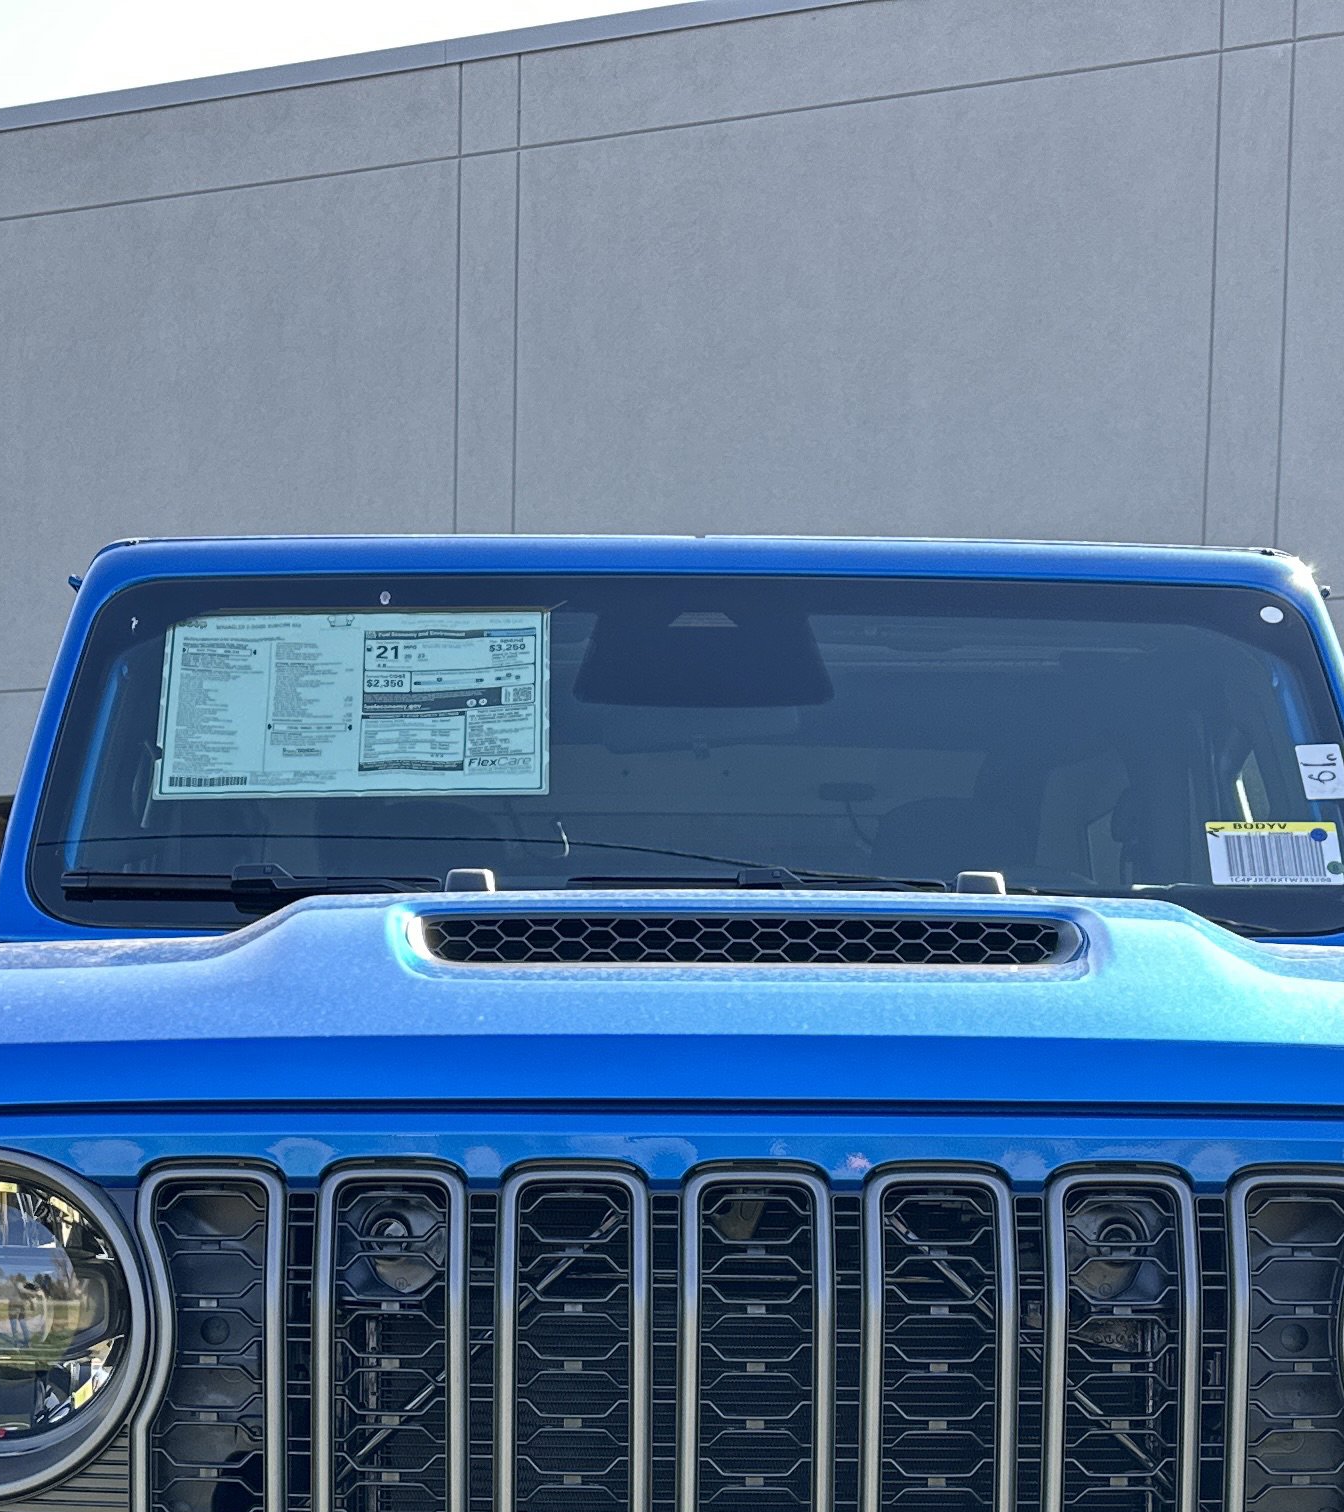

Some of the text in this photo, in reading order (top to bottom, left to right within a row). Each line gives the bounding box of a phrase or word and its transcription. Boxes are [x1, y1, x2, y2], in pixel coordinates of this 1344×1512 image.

[376, 645, 399, 660] 21
[366, 679, 404, 688] $2,350
[468, 756, 532, 767] FlexCare
